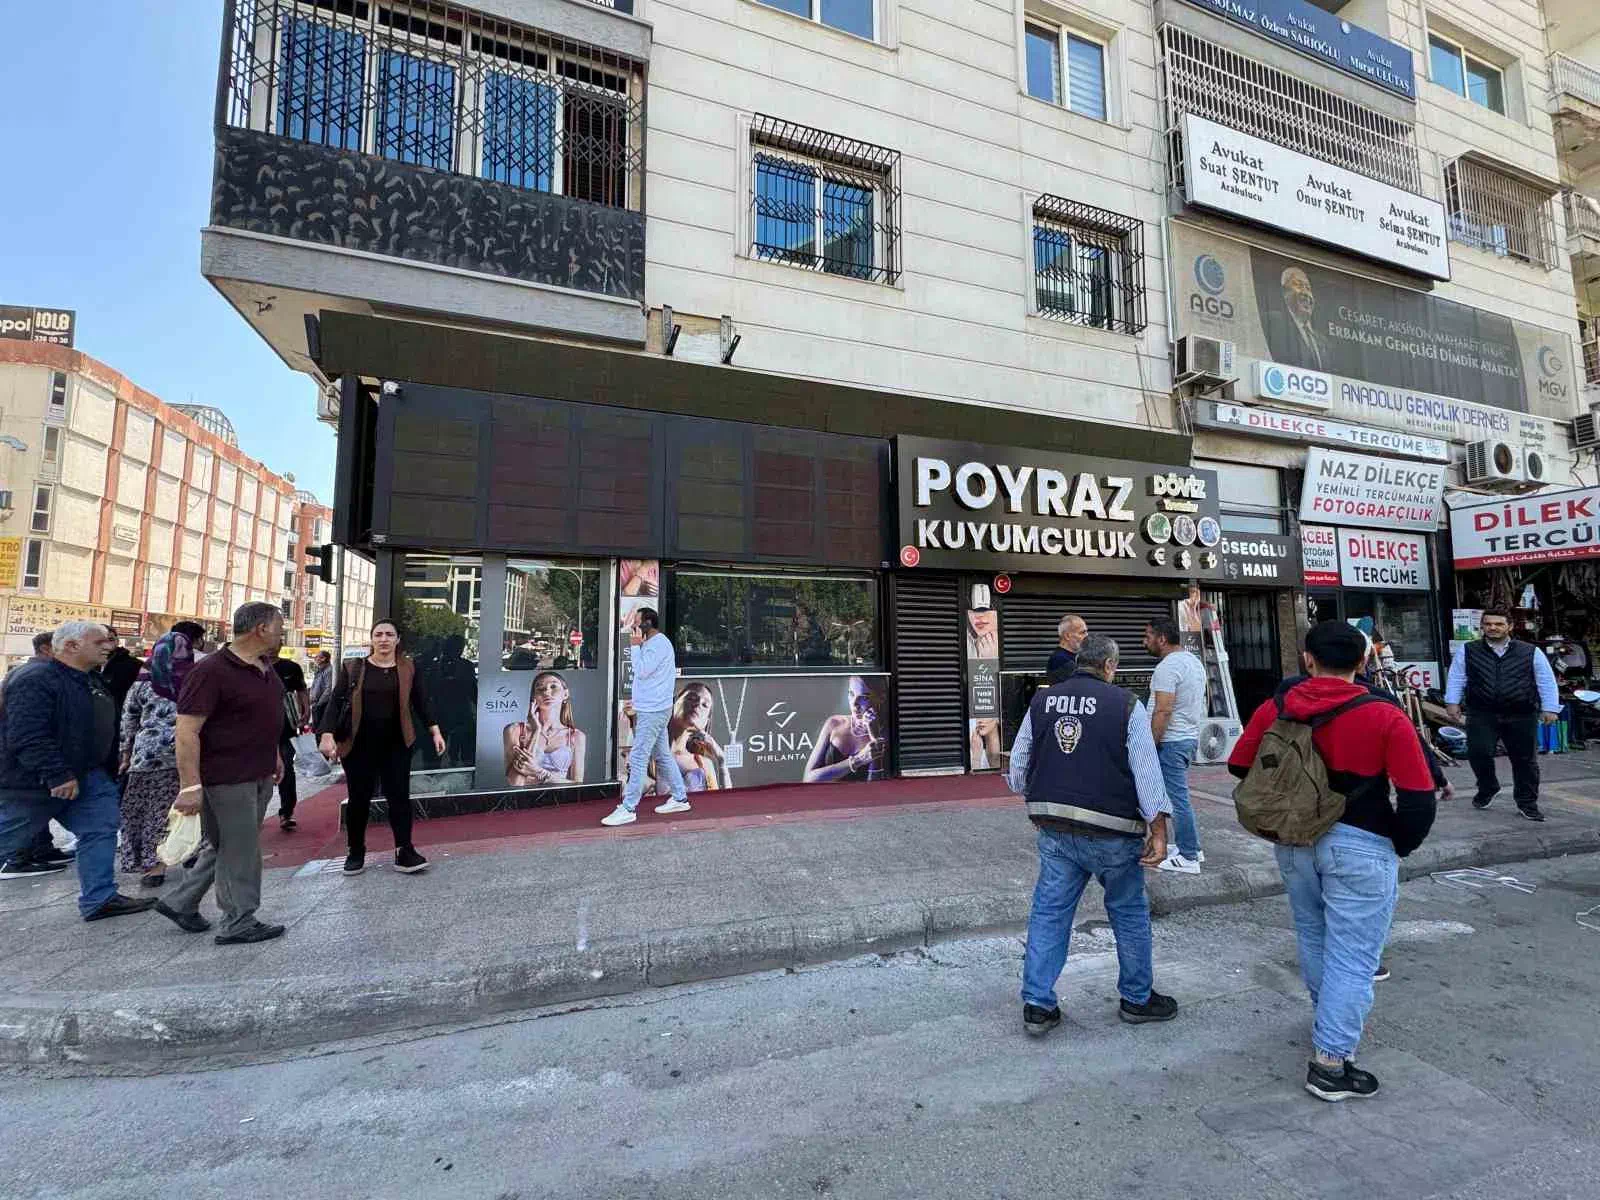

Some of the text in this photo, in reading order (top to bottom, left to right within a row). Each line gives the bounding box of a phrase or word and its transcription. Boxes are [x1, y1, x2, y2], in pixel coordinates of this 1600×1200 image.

[1287, 11, 1316, 34] Avukat
[1261, 14, 1341, 61] Özlem SARIOĞLU
[1350, 55, 1375, 77] Murat
[1366, 48, 1393, 69] Avukat
[1211, 140, 1264, 171] Avukat
[1200, 156, 1279, 194] Suat ŞENTUT
[1306, 174, 1353, 201] Avukat
[1221, 181, 1263, 202] Arabulucu
[1296, 189, 1365, 223] Onur ŞENTUT
[1389, 203, 1430, 228] Avukat
[1379, 217, 1441, 248] Selma ŞENTUT
[1395, 239, 1429, 255] Arabulucu
[1190, 293, 1234, 319] AGD
[0, 318, 31, 333] pol
[1328, 322, 1383, 346] ERBAKAN
[1385, 336, 1438, 360] GENÇLİĞİ
[1287, 373, 1328, 396] AGD
[1538, 378, 1567, 397] MGV
[1341, 383, 1403, 411] ANADOLU
[1406, 396, 1461, 424] GENÇLİK
[1463, 408, 1510, 433] DERNEĞİ
[1350, 430, 1423, 452] TERCÜME
[916, 457, 1135, 521] POYRAZ
[1153, 472, 1207, 499] DÖVİZ
[1320, 458, 1439, 494] NAZ DİLEKÇE
[1316, 482, 1435, 505] YEMİNLİ TERCÜMANLIK
[1474, 496, 1600, 532] DİLEK
[918, 518, 1137, 558] KUYUMCULUK
[1348, 534, 1419, 566] DİLEKÇE
[1485, 522, 1600, 553] TERCÜ
[1242, 563, 1278, 578] HANI
[1353, 564, 1418, 585] TERCÜME
[748, 730, 814, 753] SİNA
[756, 752, 807, 763] PIRLANTA
